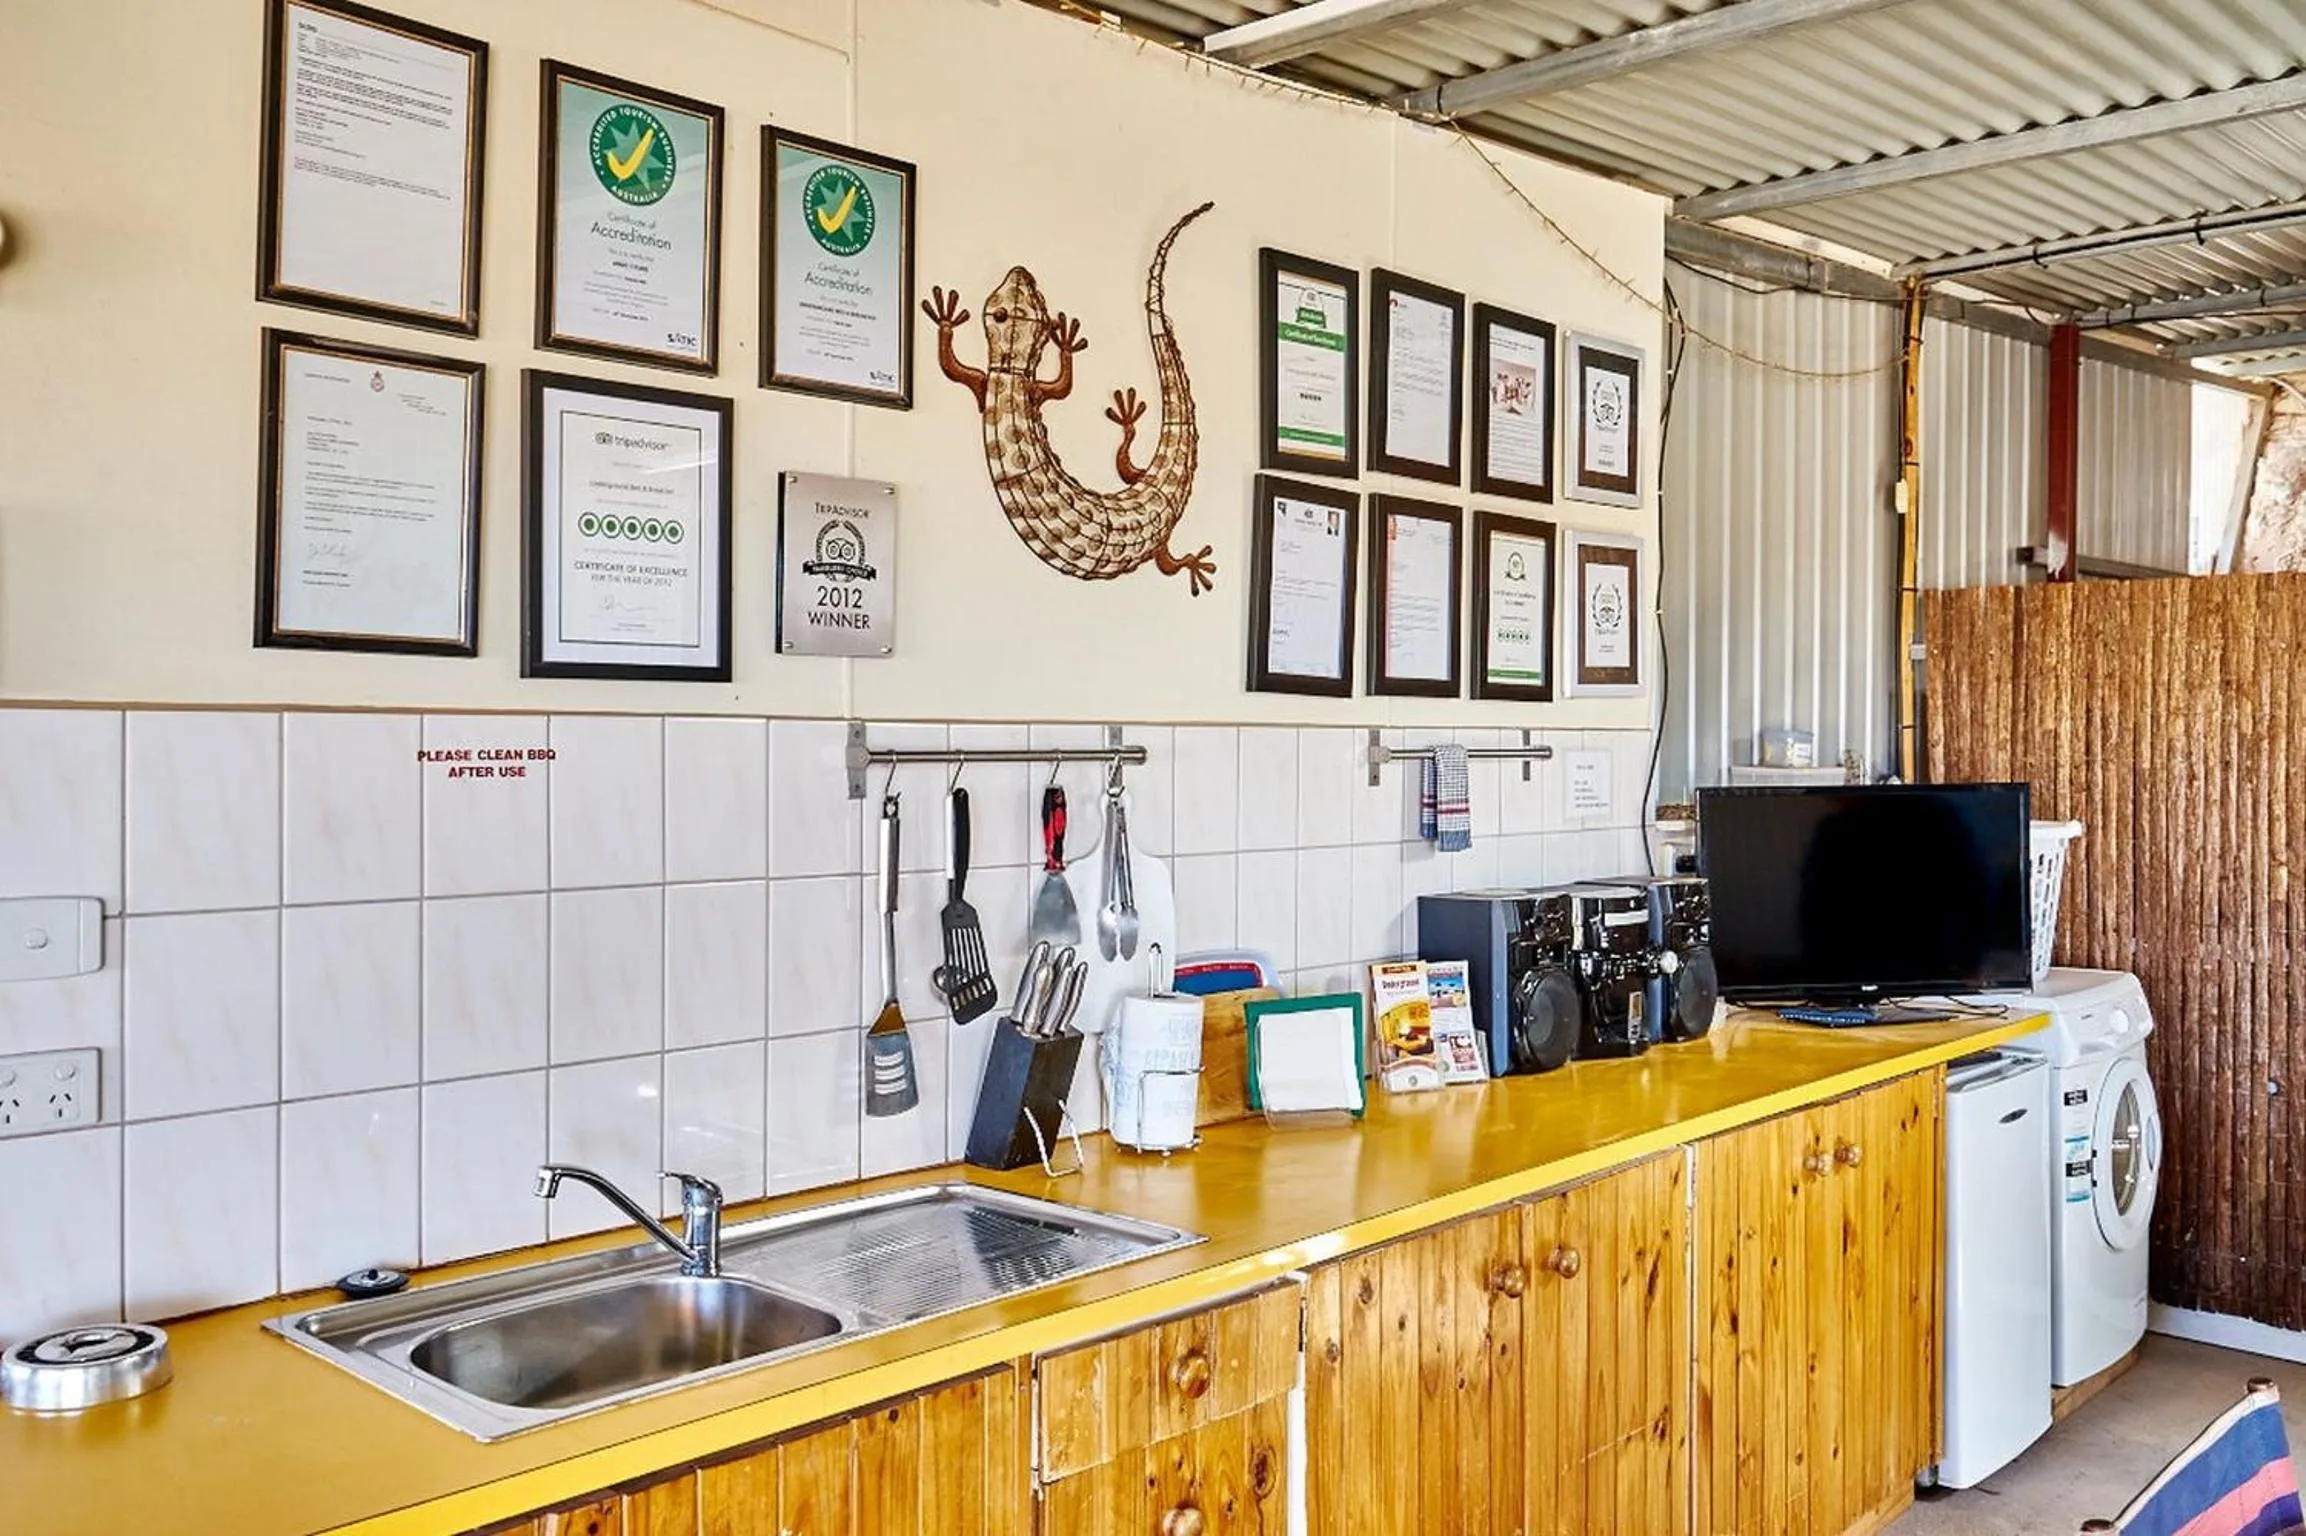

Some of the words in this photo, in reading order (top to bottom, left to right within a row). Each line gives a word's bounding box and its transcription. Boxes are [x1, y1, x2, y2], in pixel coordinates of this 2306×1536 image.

[591, 221, 672, 250] Accreditation
[574, 560, 624, 572] CERTIFICATE
[816, 585, 863, 608] 2012
[808, 611, 871, 629] WINNER
[417, 750, 472, 762] PLEASE
[477, 749, 523, 760] CLEAN
[527, 749, 556, 760] BBQ
[448, 766, 494, 777] AFTER
[499, 766, 526, 777] USE
